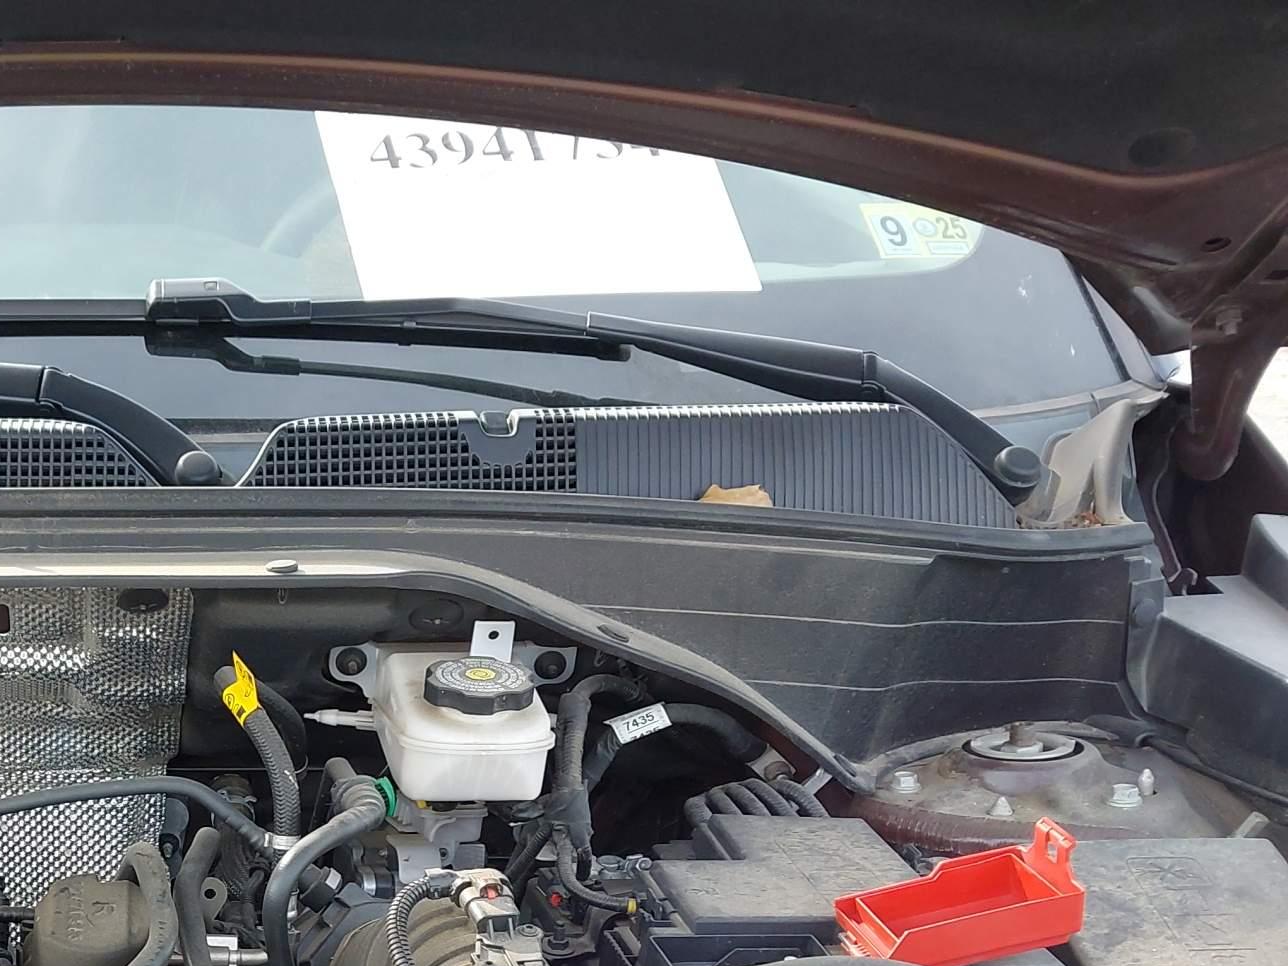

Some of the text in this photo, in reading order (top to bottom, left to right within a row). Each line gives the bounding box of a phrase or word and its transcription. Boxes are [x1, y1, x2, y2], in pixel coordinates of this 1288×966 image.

[370, 126, 660, 168] 439417
[880, 215, 968, 247] 9 25
[622, 711, 655, 731] 7435
